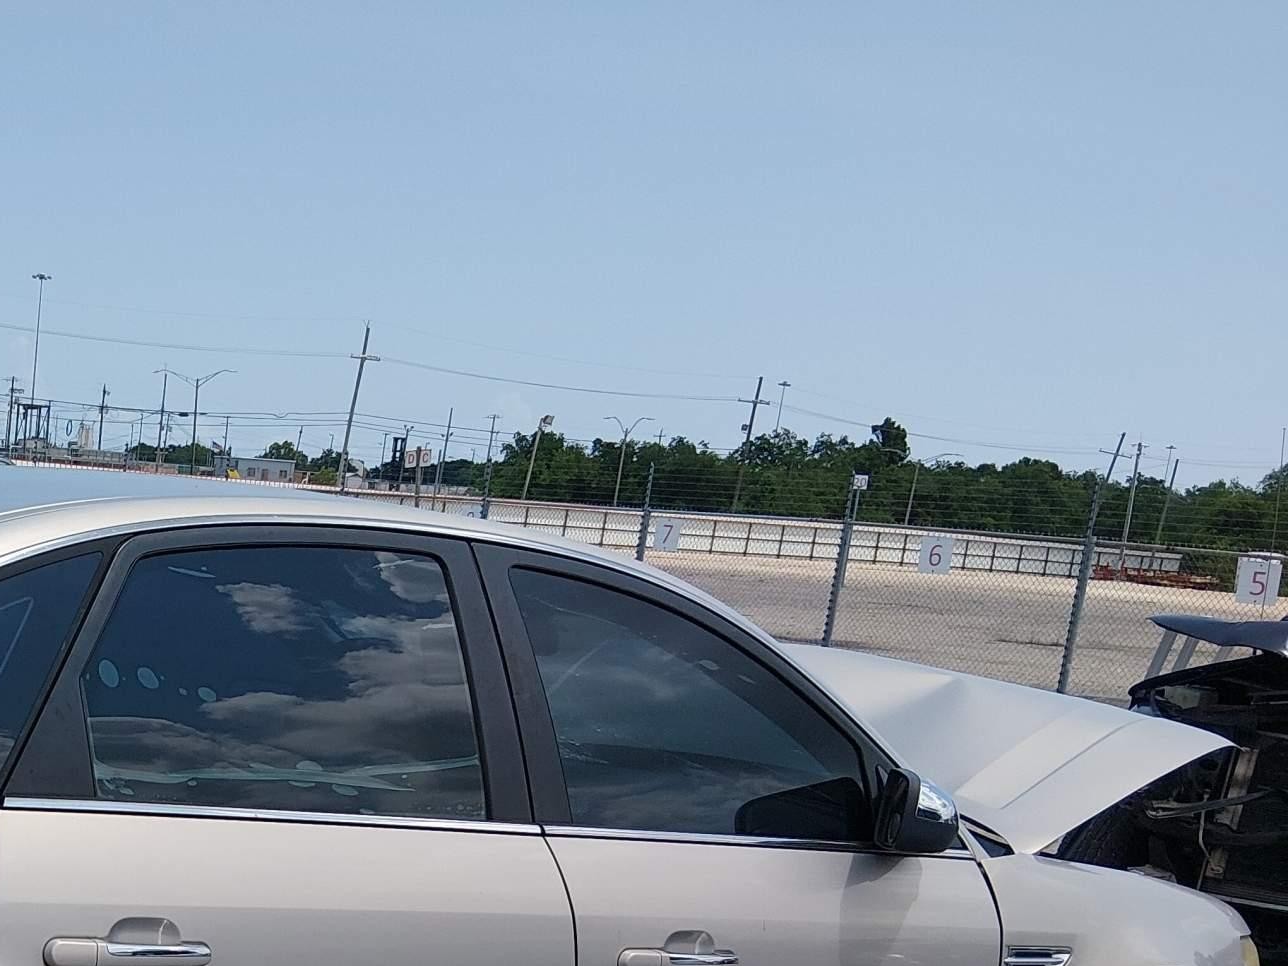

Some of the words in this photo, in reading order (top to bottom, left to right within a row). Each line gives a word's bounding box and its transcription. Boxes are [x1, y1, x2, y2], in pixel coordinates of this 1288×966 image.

[407, 453, 415, 464] D
[422, 452, 429, 463] C
[662, 524, 674, 544] 7
[929, 544, 943, 567] 6
[1249, 571, 1266, 596] 5
